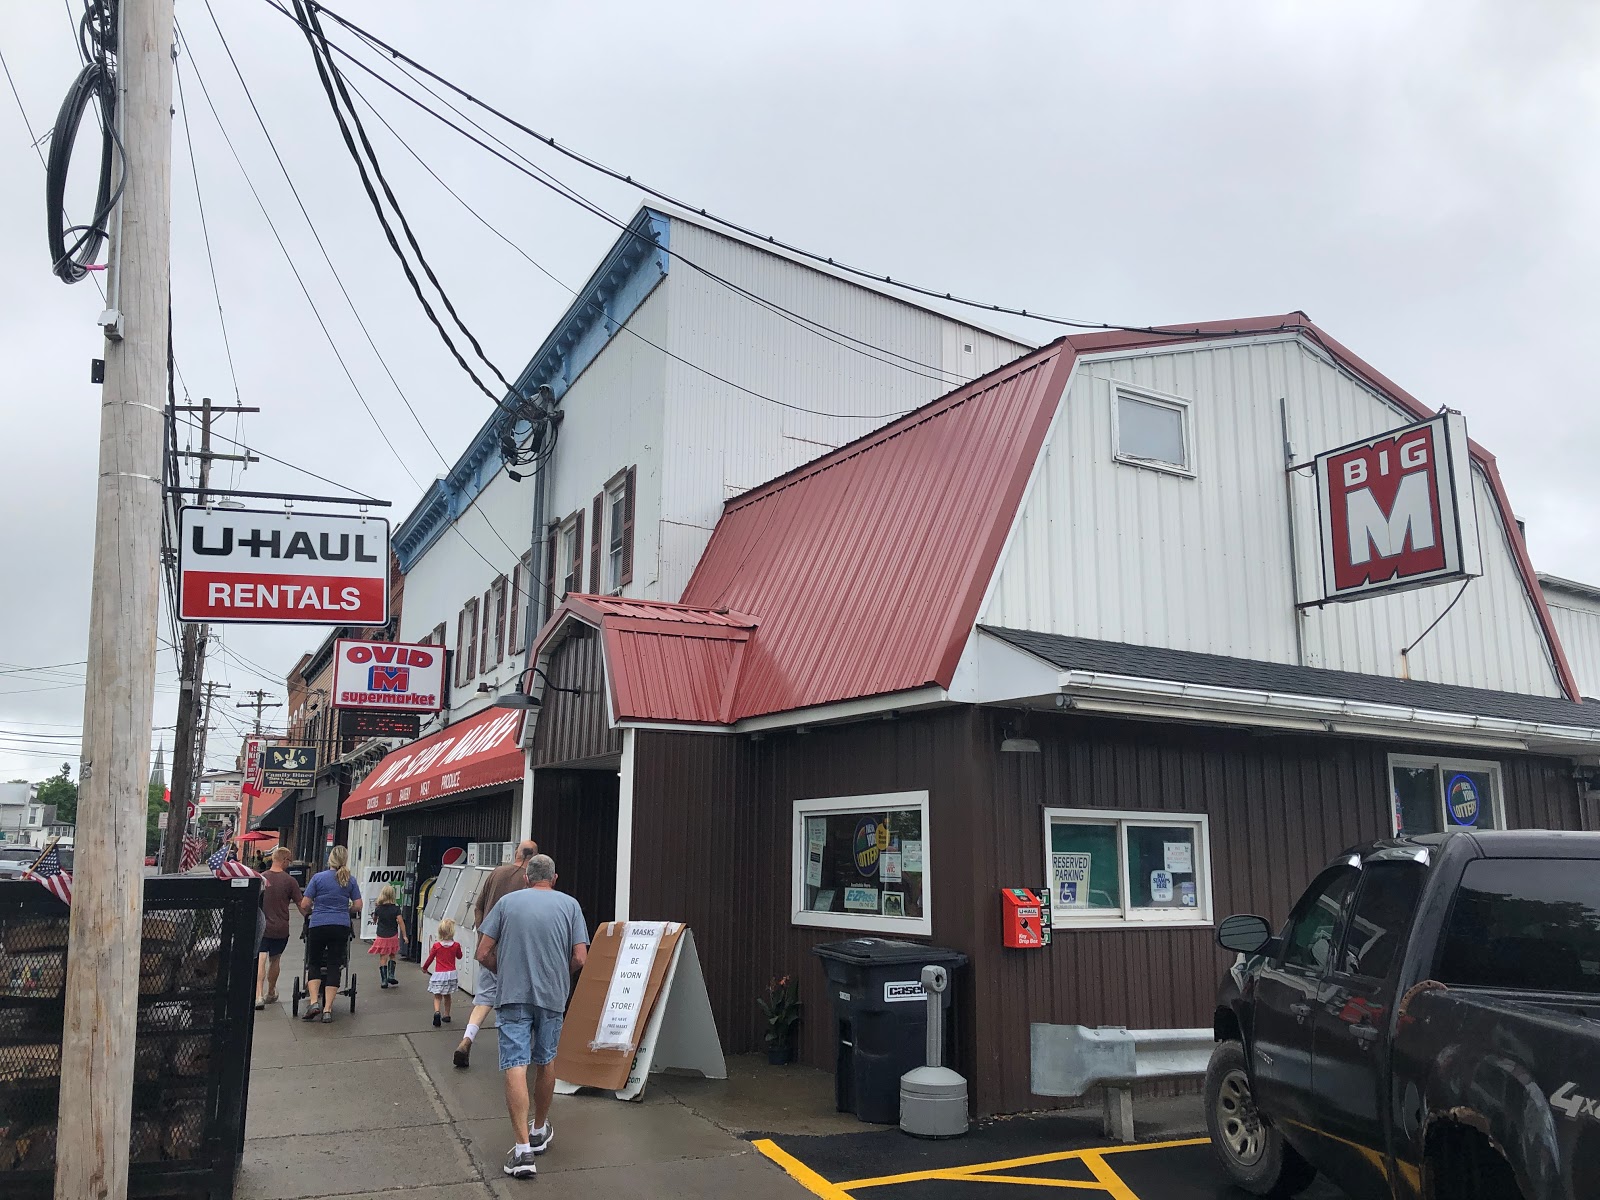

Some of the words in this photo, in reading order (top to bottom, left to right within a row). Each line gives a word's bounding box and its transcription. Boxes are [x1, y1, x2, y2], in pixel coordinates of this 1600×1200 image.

[1343, 437, 1428, 487] BIG
[1345, 469, 1436, 567] M
[193, 525, 378, 563] U-HAUL
[208, 582, 361, 611] RENTALS
[346, 645, 434, 669] OVID
[370, 671, 409, 692] M
[341, 691, 436, 705] supermarket
[441, 771, 460, 790] PRODUCE
[1052, 856, 1088, 869] RESERVED
[369, 870, 405, 883] MOVI
[1055, 869, 1084, 881] PARKING
[632, 928, 655, 936] MASKS
[629, 943, 649, 951] MUST
[630, 957, 639, 965] BE
[620, 971, 642, 979] WORN
[622, 986, 631, 994] IN
[610, 1001, 635, 1010] STORE!
